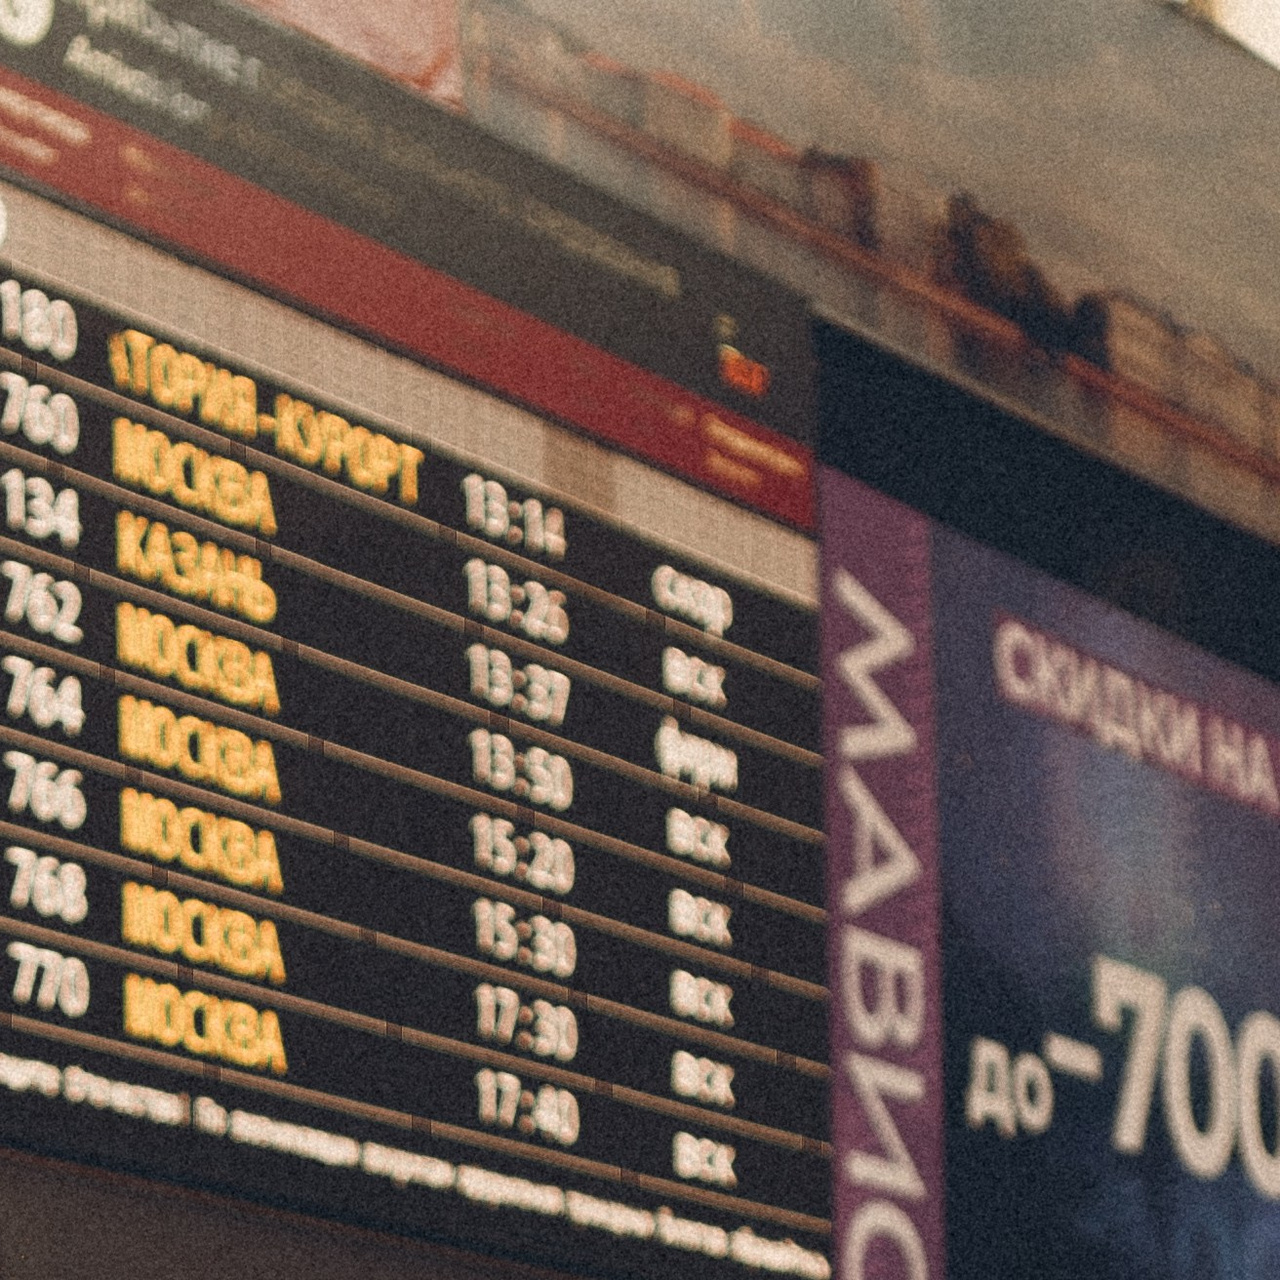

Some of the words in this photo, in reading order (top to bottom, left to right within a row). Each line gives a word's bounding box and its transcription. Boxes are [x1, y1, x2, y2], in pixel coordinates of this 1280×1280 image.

[112, 417, 277, 536] МОСКВА
[461, 473, 567, 561] 13:14
[0, 468, 82, 549] 134
[114, 509, 277, 623] КАЗАНЬ
[464, 642, 572, 727] 13:37
[0, 560, 84, 644] 762
[116, 601, 281, 715] МОСКВА
[1, 655, 86, 737] 764
[118, 695, 282, 804] МОСКВА
[468, 812, 575, 896] 15:20
[3, 750, 88, 831] 766
[120, 787, 284, 894] МОСКВА
[471, 897, 577, 978] 15:30
[4, 846, 89, 924] 768
[121, 881, 286, 985] МОСКВА
[472, 983, 579, 1062] 17:30
[6, 940, 91, 1018] 770
[123, 973, 288, 1075] МОСКВА
